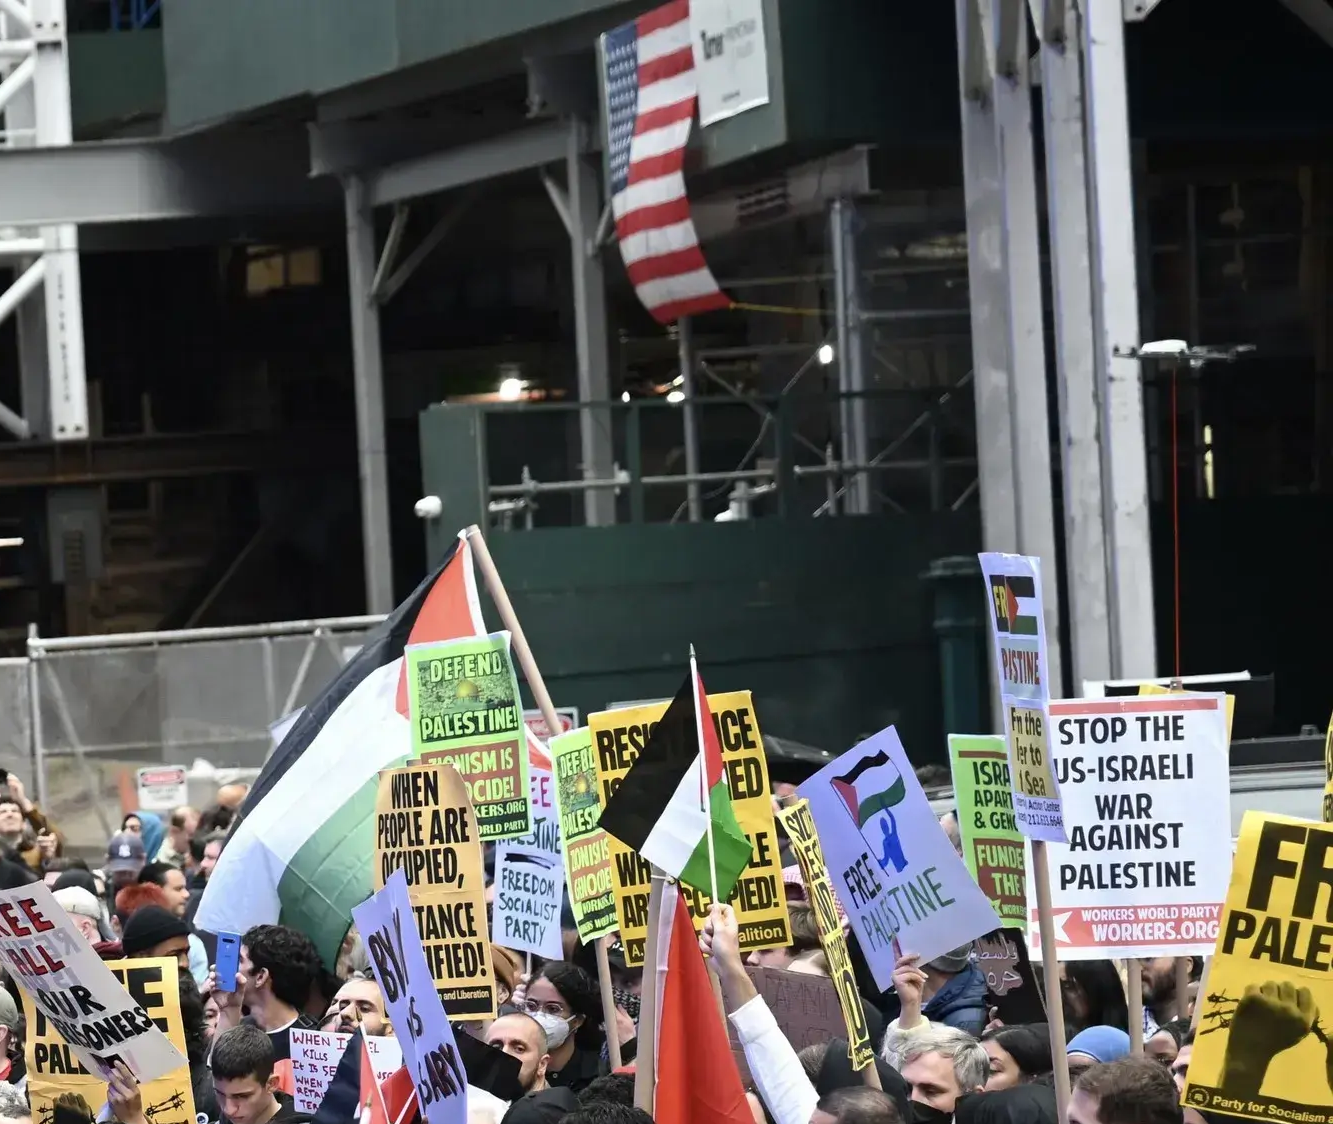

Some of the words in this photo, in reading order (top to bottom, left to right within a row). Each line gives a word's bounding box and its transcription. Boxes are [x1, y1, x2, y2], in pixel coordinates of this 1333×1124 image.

[429, 650, 503, 684] DEFEND
[420, 705, 519, 741] PALESTINE!
[1025, 711, 1042, 736] the
[1058, 716, 1127, 745] STOP
[1135, 715, 1185, 742] THE
[501, 747, 514, 771] IS
[1030, 742, 1043, 768] to
[1053, 753, 1194, 784] US-ISRAELI
[973, 761, 1011, 786] ISRA
[1026, 776, 1047, 797] Sea
[391, 770, 439, 810] WHEN
[973, 789, 1014, 807] APART
[474, 800, 526, 820] KERS.ORG
[974, 811, 987, 829] &
[1094, 793, 1153, 821] WAR
[378, 810, 425, 850] PEOPLE
[430, 807, 470, 846] ARE
[477, 820, 503, 836] ORLD
[504, 818, 527, 833] PARTY
[1069, 822, 1184, 852] AGAINST
[976, 844, 1024, 871] FUNDE
[1245, 820, 1333, 921] FR
[501, 867, 556, 898] FREEDOM
[842, 852, 883, 910] FREE
[991, 872, 1020, 897] THE
[1060, 860, 1196, 890] PALESTINE
[498, 892, 558, 922] SOCIALIST
[860, 866, 956, 953] PALESTINE
[1081, 908, 1135, 922] WORKERS
[1137, 906, 1179, 921] WORLD
[1180, 905, 1220, 919] PARTY
[412, 902, 478, 941] TANCE
[504, 916, 546, 948] PARTY
[738, 926, 783, 943] alition
[1091, 920, 1220, 942] WORKERS.ORG
[8, 943, 64, 977] ALL
[36, 984, 107, 1020] OUR
[443, 991, 456, 1001] and
[456, 989, 490, 1001] Liberation
[46, 1006, 153, 1052] PRISONERS
[292, 1031, 331, 1047] WHEN
[303, 1048, 328, 1062] KILLS
[308, 1063, 319, 1073] IS
[295, 1075, 323, 1089] WHEN
[1212, 1095, 1246, 1113] Party
[1248, 1100, 1267, 1114] for
[1267, 1102, 1327, 1124] Socialism
